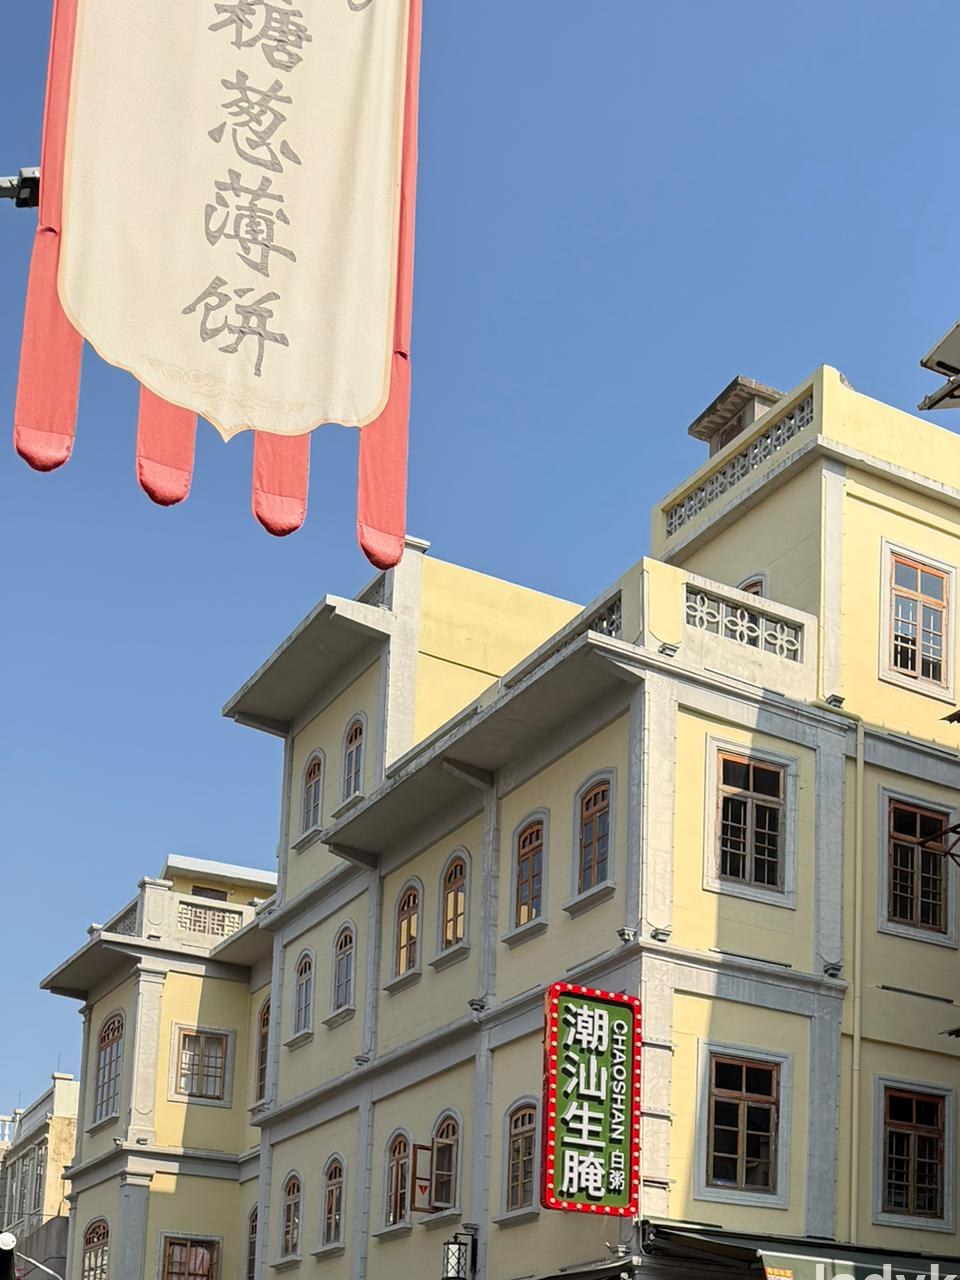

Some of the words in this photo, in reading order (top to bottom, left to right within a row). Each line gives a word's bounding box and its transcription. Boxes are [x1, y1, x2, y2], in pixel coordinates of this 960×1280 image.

[183, 0, 312, 378] 糖葱薄饼
[562, 1002, 609, 1198] 潮汕生腌
[609, 1019, 629, 1140] CHAOSHAN
